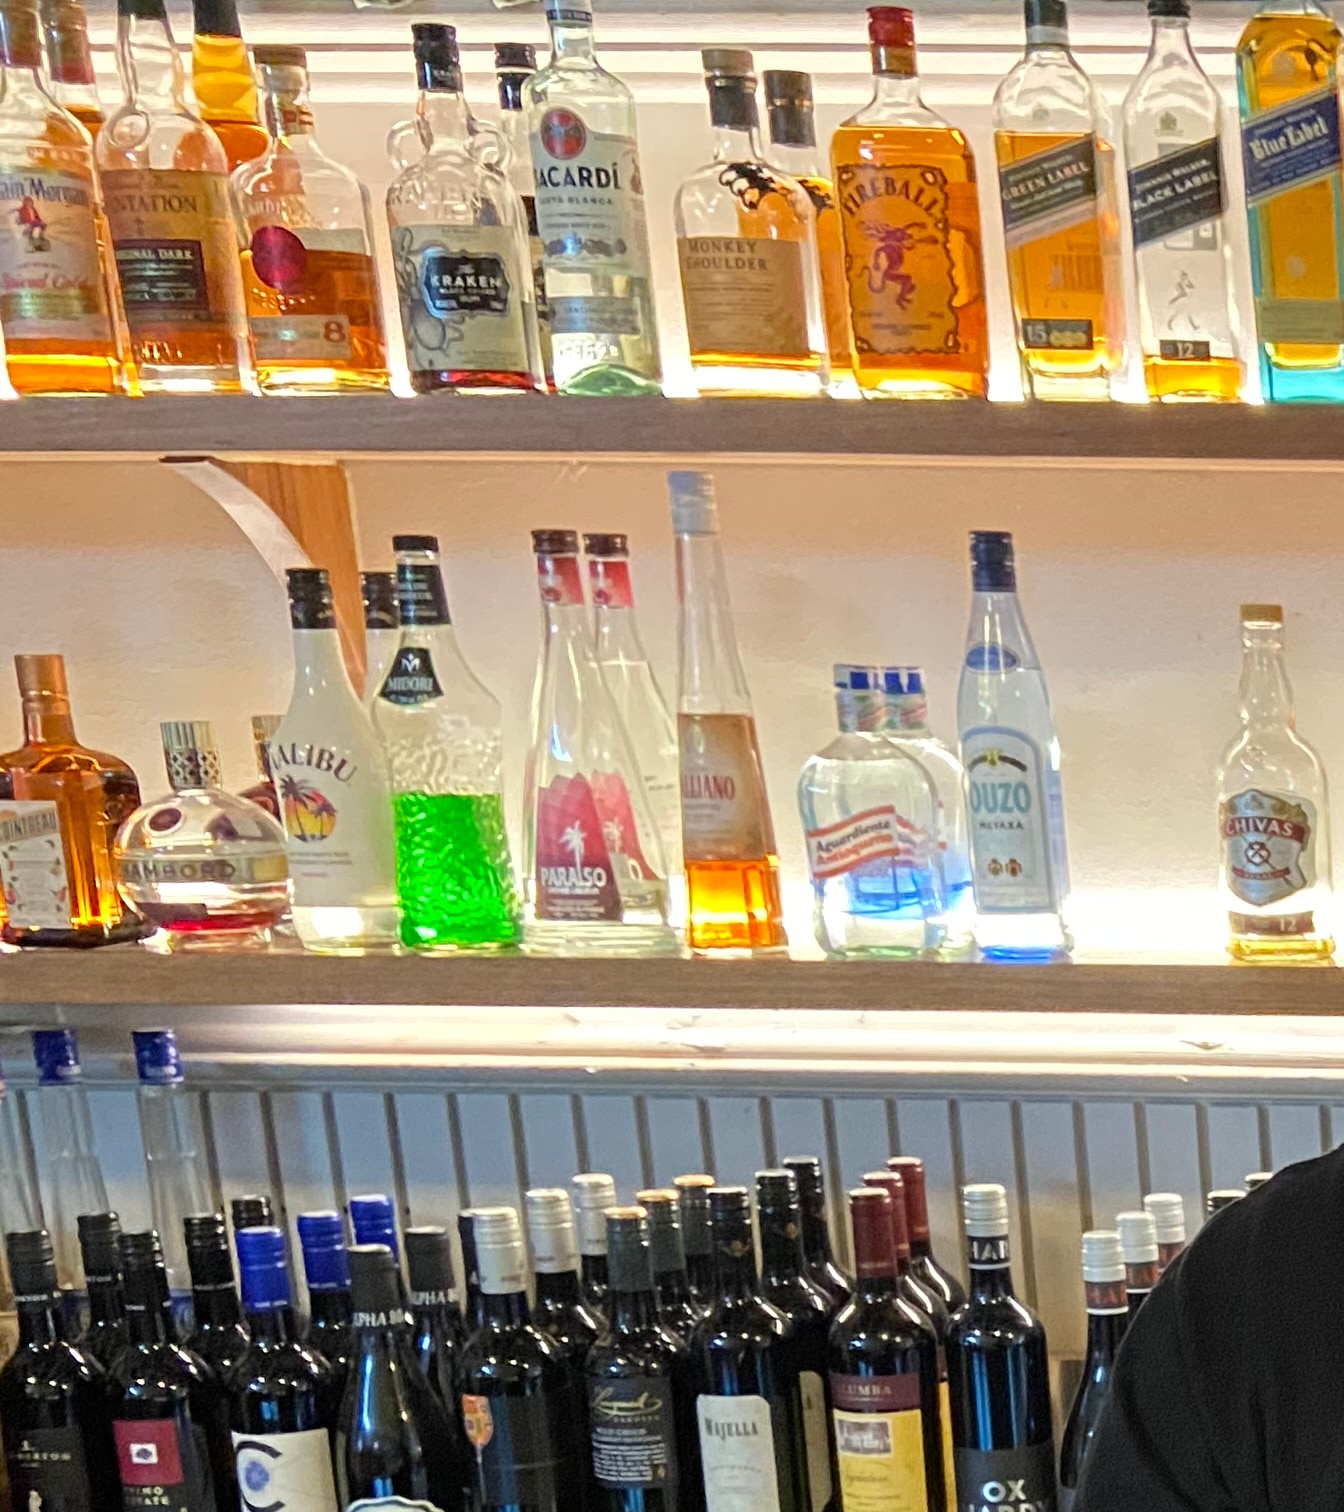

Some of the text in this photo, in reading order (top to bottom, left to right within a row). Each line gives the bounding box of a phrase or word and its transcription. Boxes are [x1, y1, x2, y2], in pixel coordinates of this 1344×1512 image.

[1250, 114, 1329, 160] Blue Label
[1002, 175, 1045, 200] GREEN
[1048, 162, 1089, 183] LABEL
[1175, 171, 1217, 194] LABEL
[842, 180, 946, 228] FIREBALL
[159, 249, 194, 261] DARK
[688, 240, 757, 253] MONKEY
[686, 257, 767, 270] SHOULDER
[431, 274, 500, 289] KRAKEN
[323, 321, 345, 343] 8
[1026, 324, 1048, 343] 15
[1175, 342, 1195, 359] 12
[969, 781, 1032, 814] OUZO
[979, 820, 1025, 831] METAXA
[1225, 817, 1294, 837] CHIVAS
[815, 819, 892, 853] Aguardiente
[1279, 917, 1297, 932] 12
[982, 1479, 1025, 1503] OX
